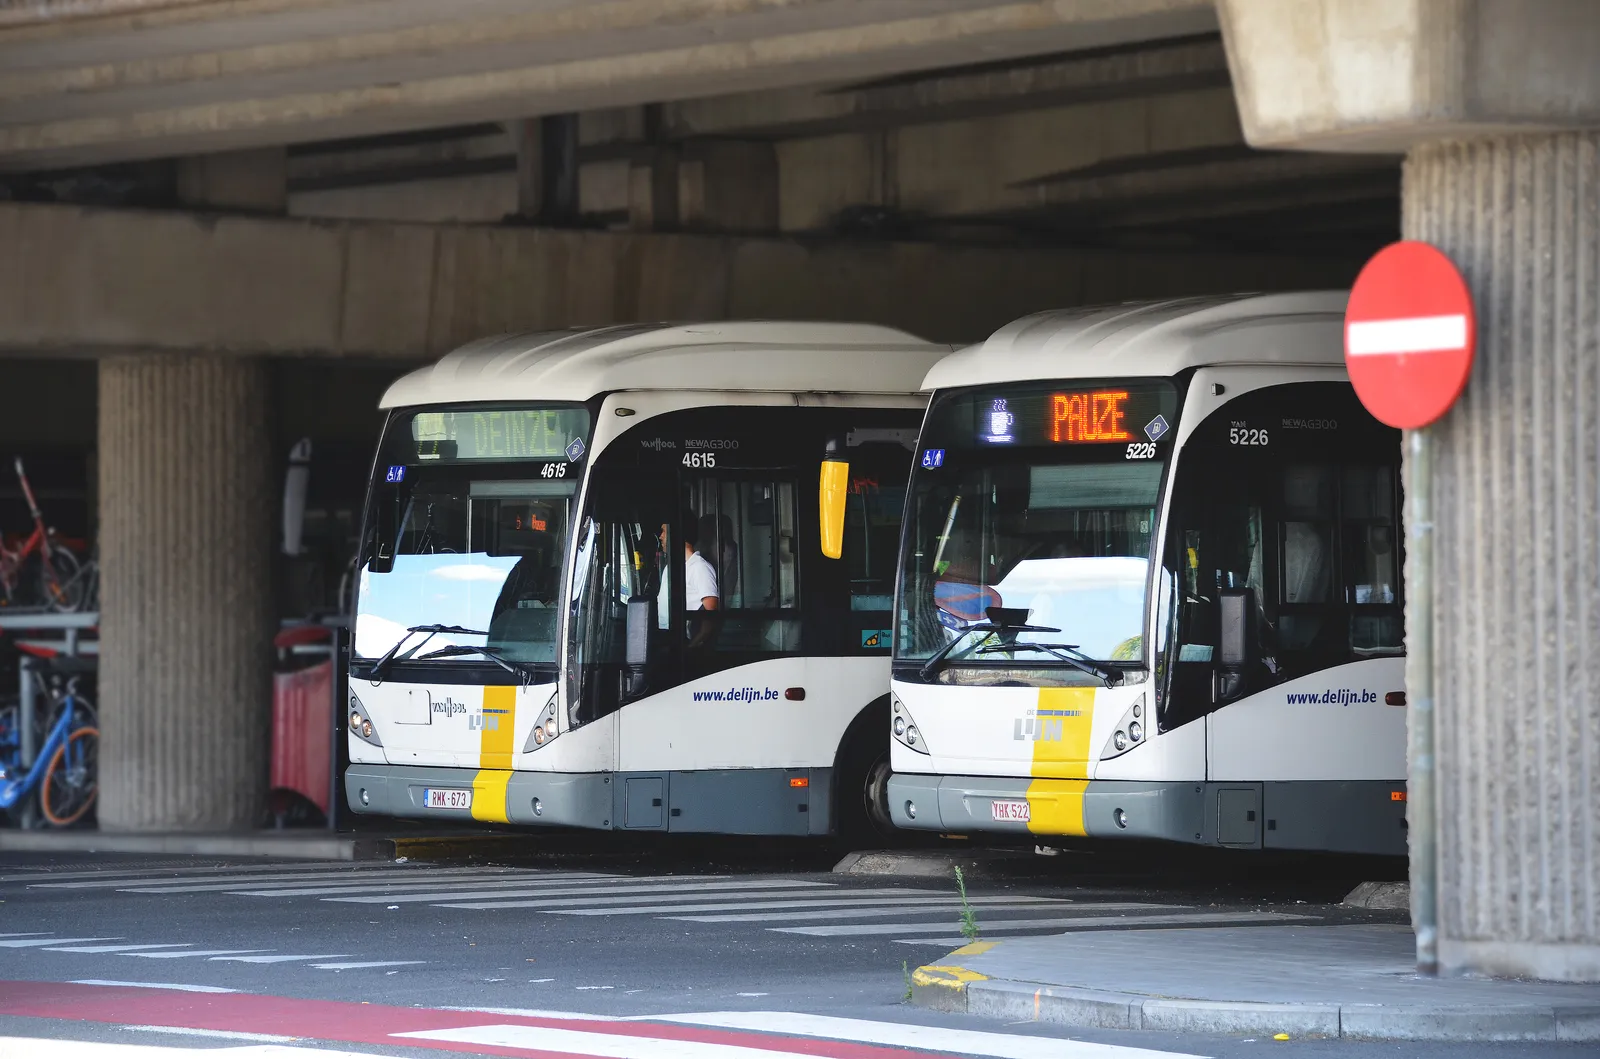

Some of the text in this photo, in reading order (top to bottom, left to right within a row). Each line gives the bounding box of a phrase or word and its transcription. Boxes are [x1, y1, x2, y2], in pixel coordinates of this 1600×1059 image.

[1052, 392, 1129, 442] PAUZE
[474, 411, 557, 455] DEINZE
[1229, 428, 1269, 446] 5226
[1125, 442, 1156, 459] 5226
[682, 452, 716, 468] 4615
[541, 463, 566, 478] 4615
[693, 687, 779, 704] www.delijn.be
[1287, 689, 1377, 706] www.delijn.be
